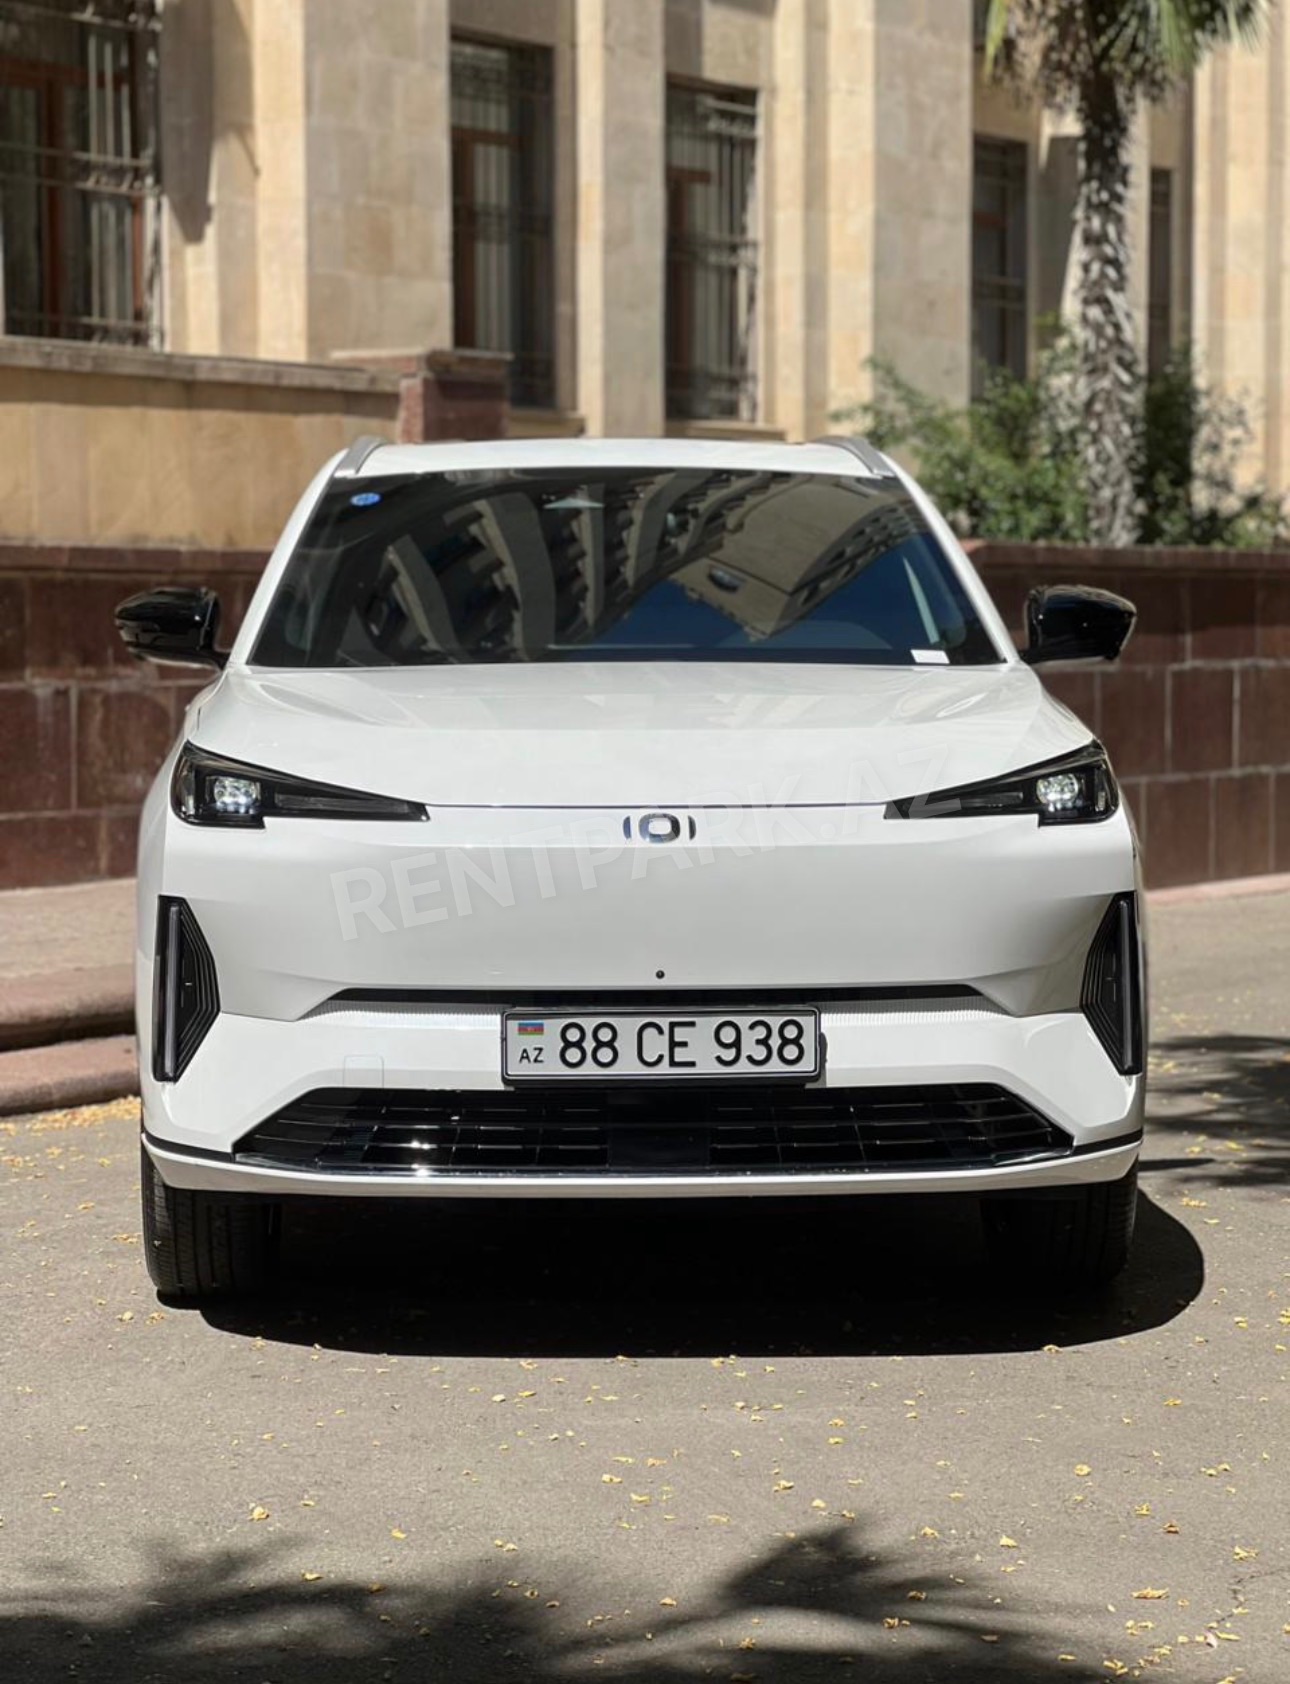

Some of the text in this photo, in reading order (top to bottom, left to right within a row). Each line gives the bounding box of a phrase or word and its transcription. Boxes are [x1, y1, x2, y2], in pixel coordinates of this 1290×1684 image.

[518, 1047, 544, 1064] AZ
[559, 1018, 805, 1069] 88 CE 938
